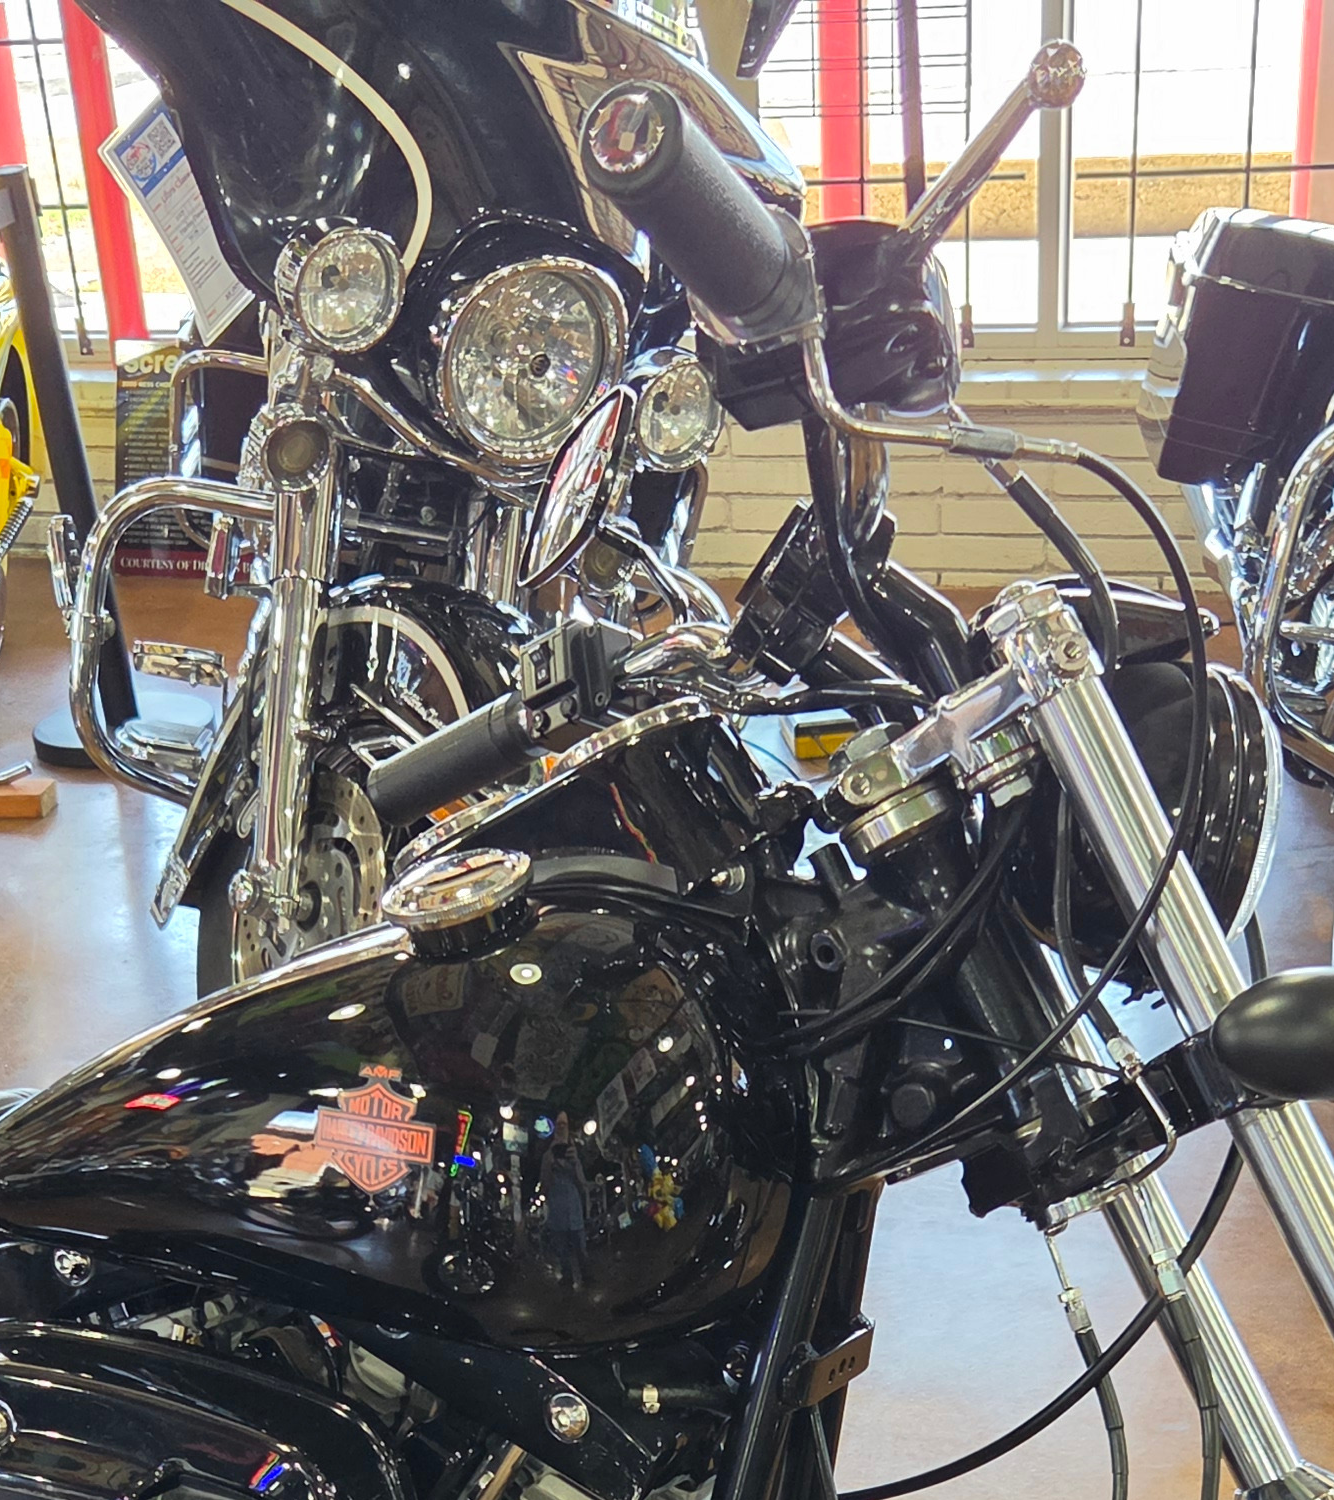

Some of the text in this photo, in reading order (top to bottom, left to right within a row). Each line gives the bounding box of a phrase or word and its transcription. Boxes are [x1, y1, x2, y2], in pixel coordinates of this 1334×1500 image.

[120, 557, 175, 570] COURTESY
[176, 559, 190, 570] OF
[360, 1064, 402, 1079] AMF
[348, 1093, 402, 1121] MOTOR
[343, 1150, 398, 1184] CYCLES
